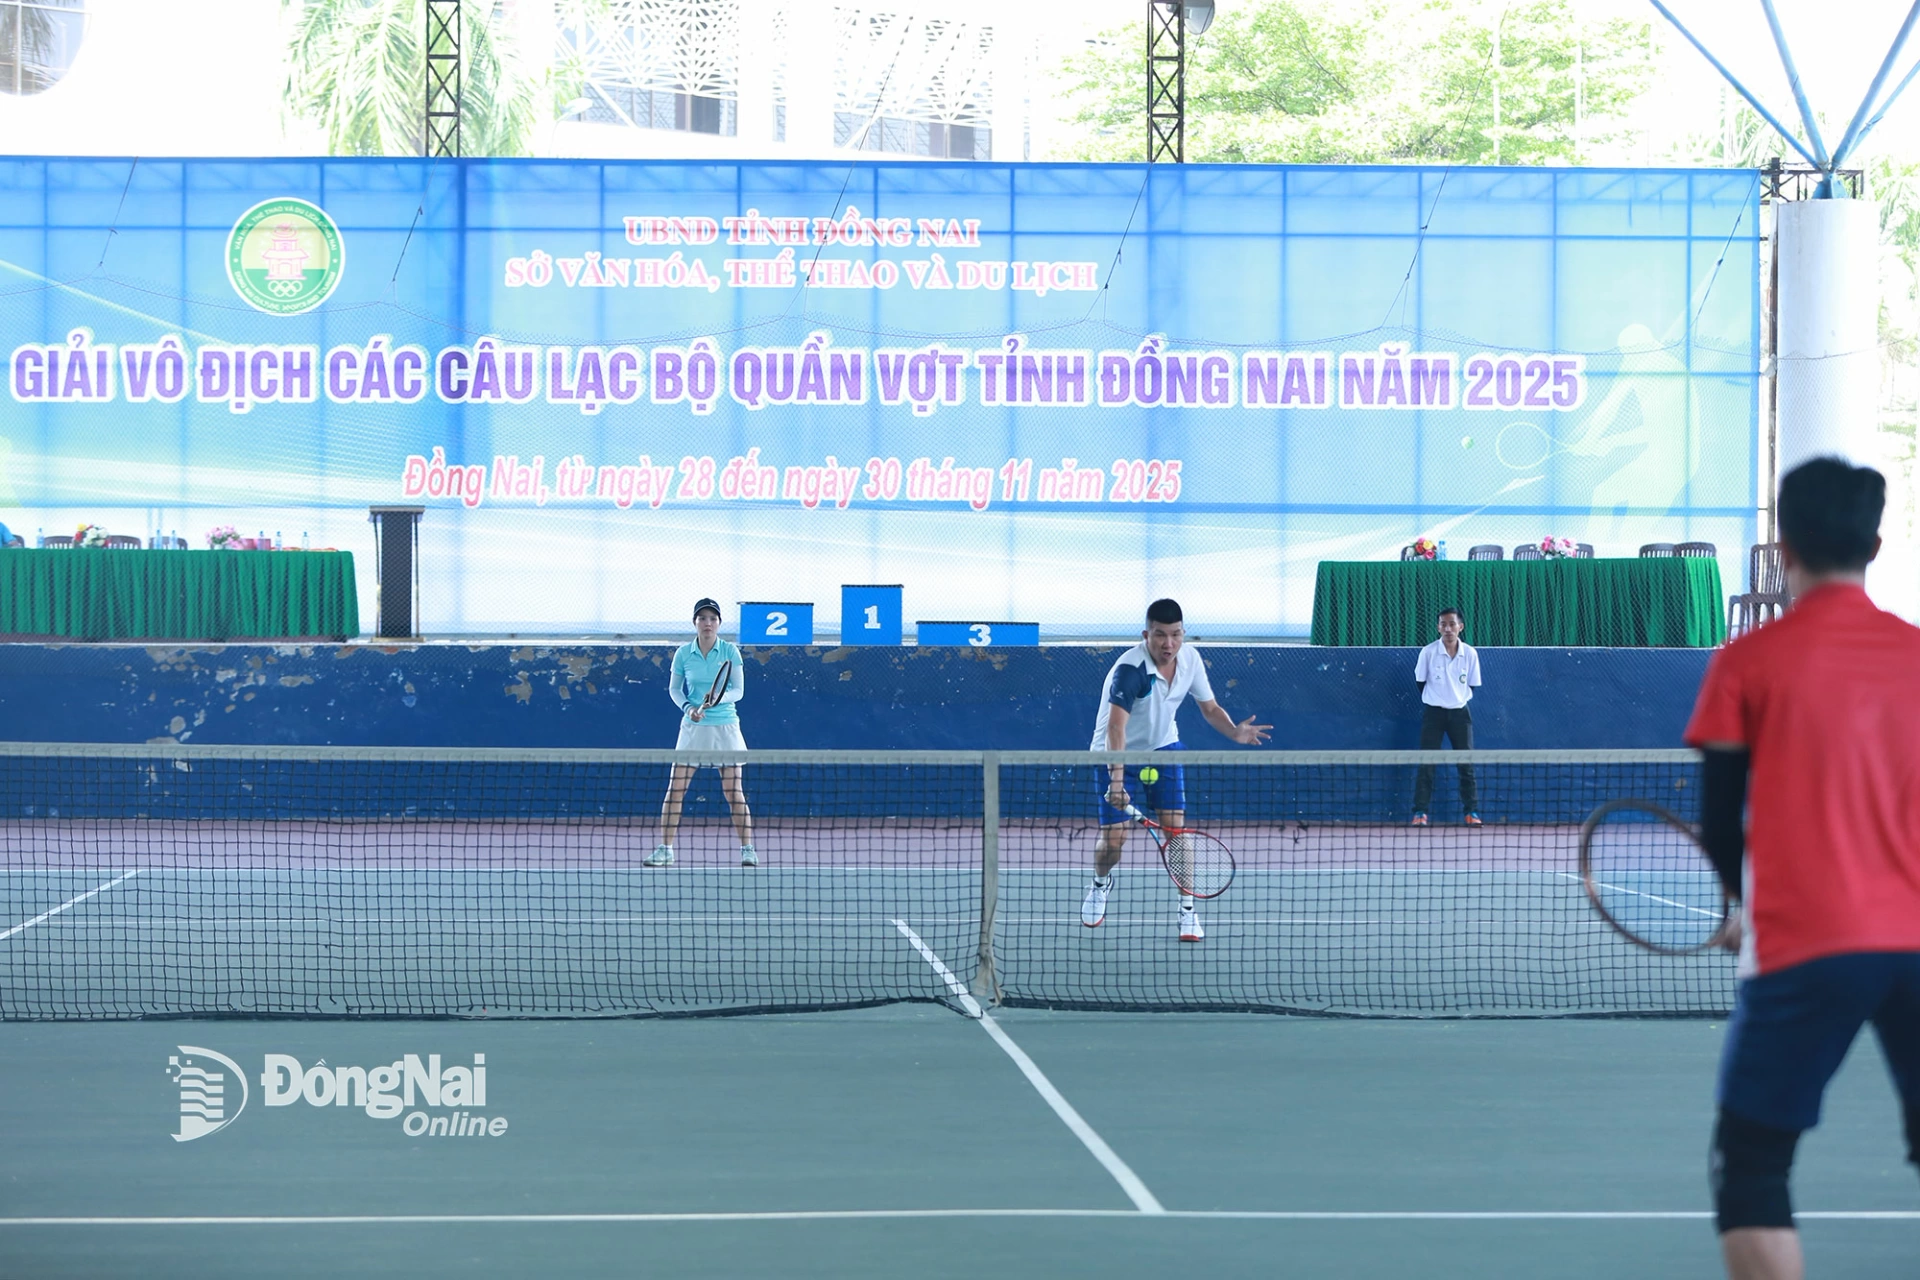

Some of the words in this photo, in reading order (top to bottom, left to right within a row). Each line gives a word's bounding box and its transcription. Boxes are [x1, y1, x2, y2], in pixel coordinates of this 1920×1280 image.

[626, 218, 717, 243] UBND
[724, 210, 807, 244] TỈNH
[814, 208, 912, 246] ĐỒNG
[919, 219, 981, 246] NAI
[507, 252, 551, 286] SỞ
[559, 253, 629, 286] VĂN
[637, 251, 720, 292] HÓA,
[726, 249, 795, 286] THỂ
[803, 260, 897, 288] THAO
[904, 254, 950, 288] VÀ
[957, 262, 1007, 289] DU
[1012, 263, 1096, 296] LỊCH
[14, 333, 108, 399] GIẢI
[125, 339, 184, 399] VÔ
[200, 350, 311, 410] ĐỊCH
[328, 340, 422, 400] CÁC
[439, 341, 533, 400] CÂU
[550, 351, 638, 411] LẠC
[655, 342, 717, 412] BỘ
[733, 335, 862, 406] QUẦN
[877, 349, 964, 413] VỢT
[978, 337, 1085, 403] TỈNH
[1099, 338, 1229, 405] ĐỒNG
[1246, 357, 1326, 405] NAI
[1344, 348, 1451, 406] NĂM
[1466, 359, 1579, 407] 2025
[404, 448, 483, 507] Đồng
[492, 456, 546, 503] Nai,
[557, 456, 592, 497] từ
[600, 455, 672, 507] ngày
[679, 458, 716, 498] 28
[721, 449, 775, 499] đến
[784, 457, 858, 509] ngày
[864, 459, 900, 499] 30
[907, 458, 992, 510] tháng
[1000, 459, 1032, 500] 11
[1040, 460, 1102, 500] năm
[1110, 460, 1181, 501] 2025
[765, 611, 788, 636] 2
[864, 605, 881, 629] 1
[968, 624, 992, 647] 3
